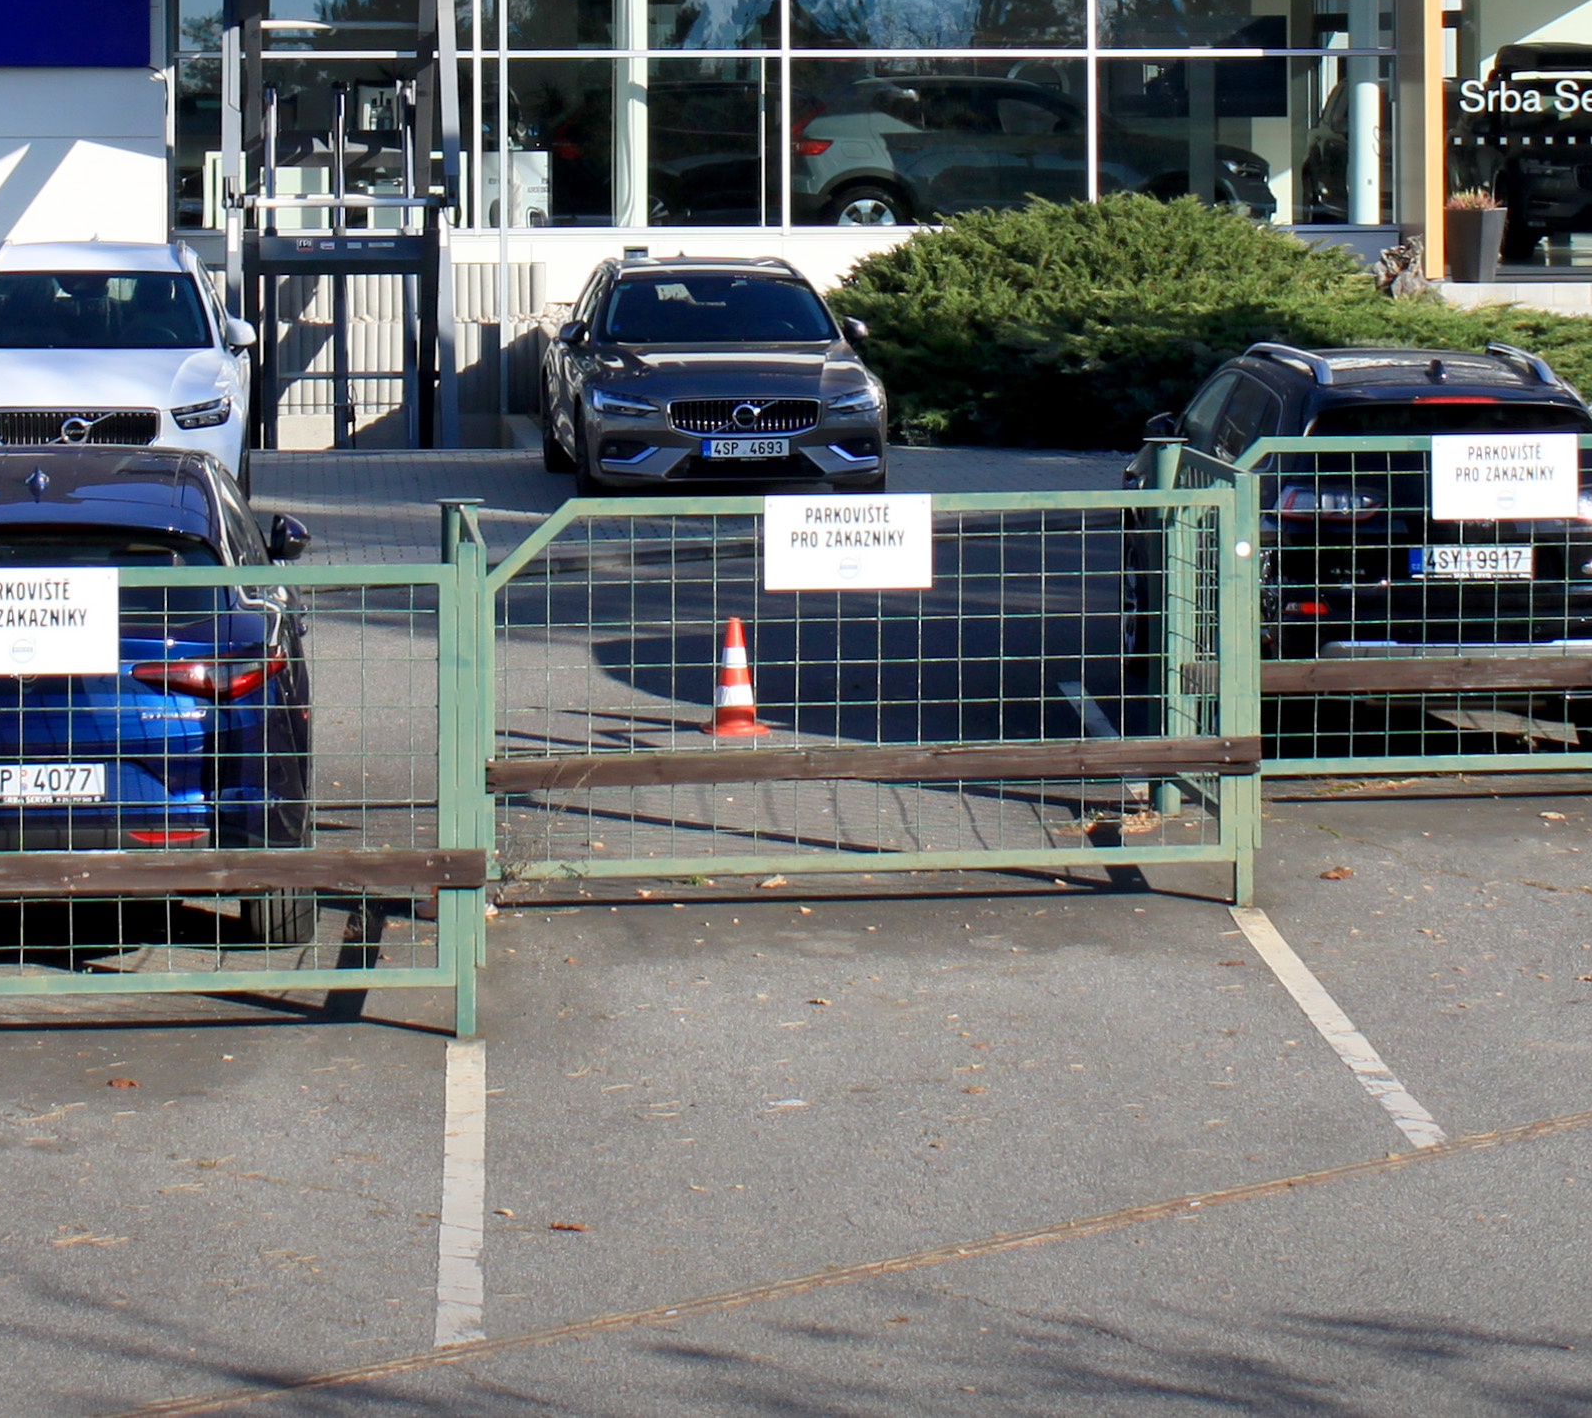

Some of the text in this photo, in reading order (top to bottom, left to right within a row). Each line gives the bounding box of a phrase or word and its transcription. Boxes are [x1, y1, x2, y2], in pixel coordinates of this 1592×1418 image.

[1459, 79, 1543, 113] Srba
[714, 441, 783, 455] 4SP 4693
[1467, 443, 1542, 460] PARKOVIŠTĚ
[1456, 463, 1555, 482] PRO ZÁKAZNÍKY
[805, 503, 890, 524] PARKOVIŠTĚ
[791, 528, 905, 548] PRO ZÁKAZNÍKY
[1427, 550, 1522, 571] 4SY 9917
[33, 768, 92, 792] 4077
